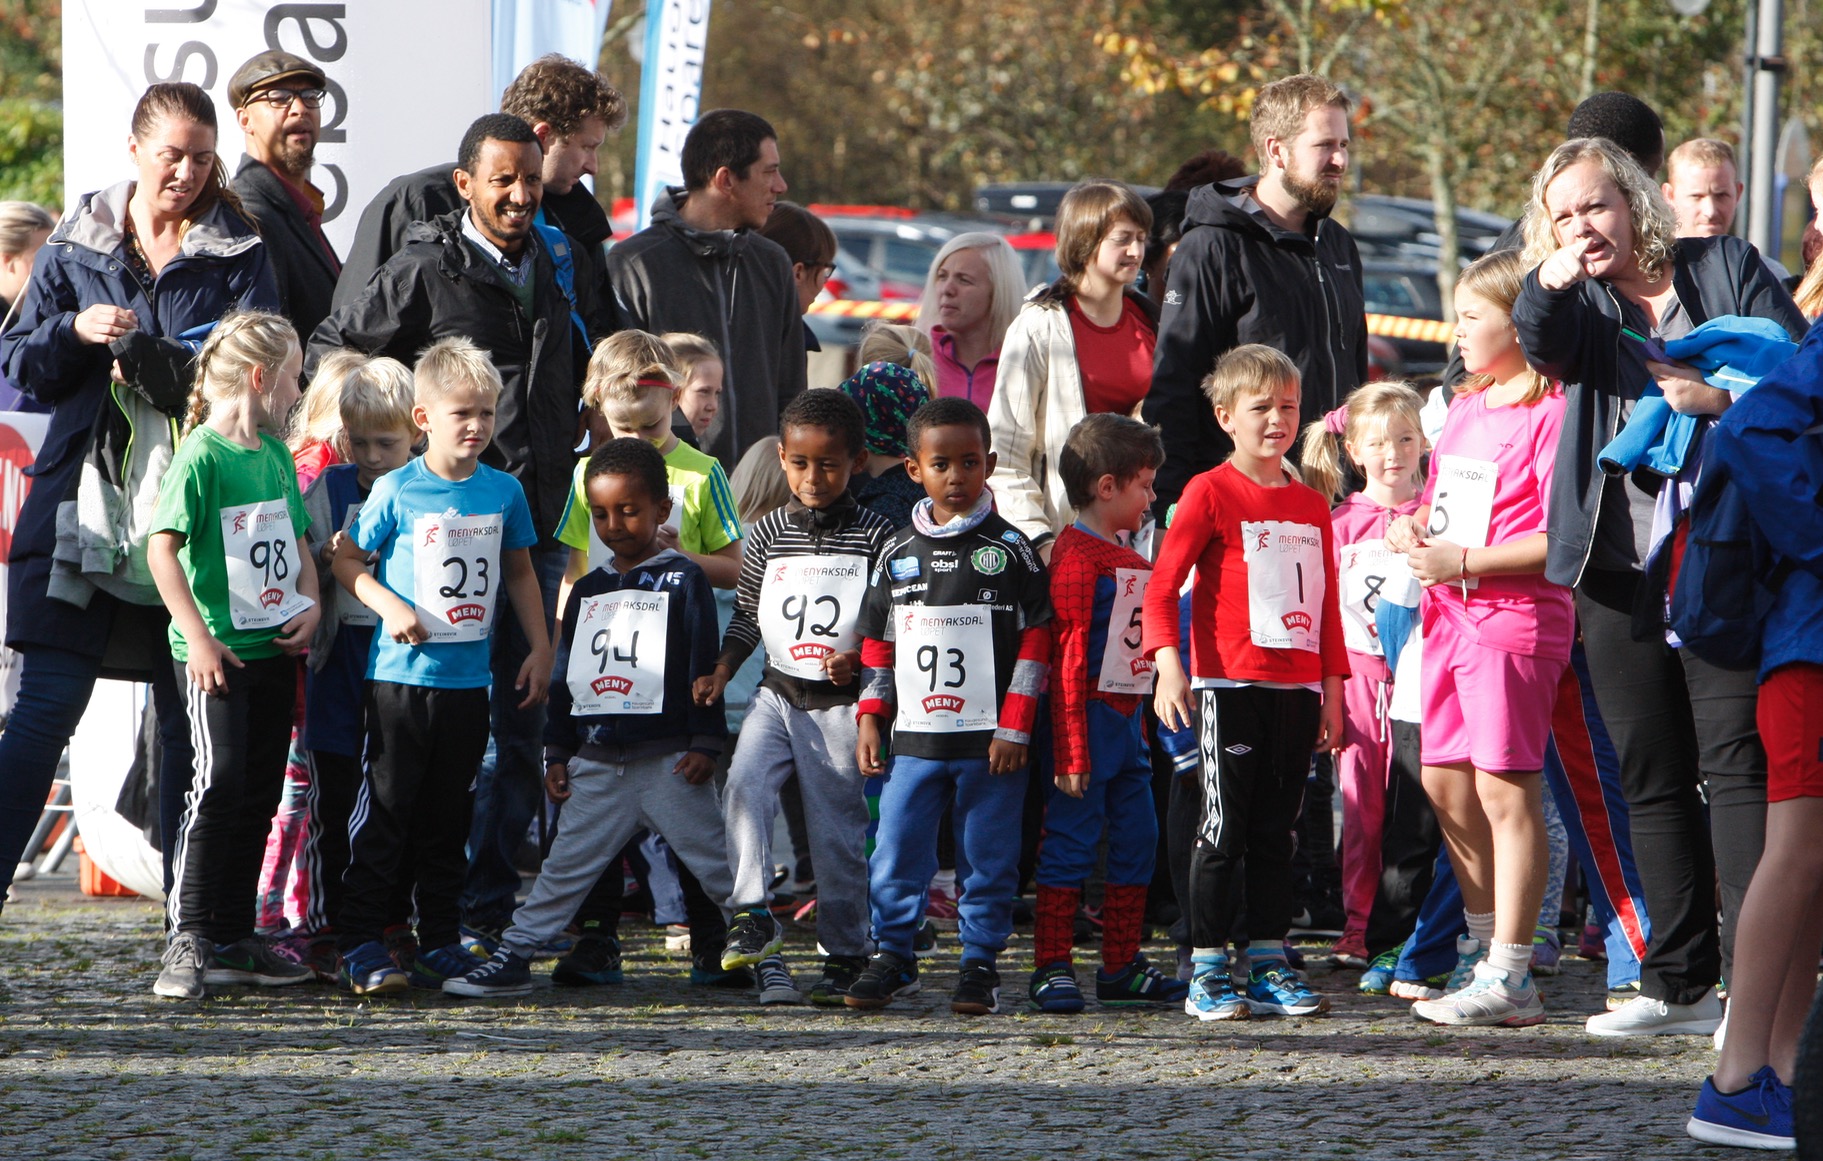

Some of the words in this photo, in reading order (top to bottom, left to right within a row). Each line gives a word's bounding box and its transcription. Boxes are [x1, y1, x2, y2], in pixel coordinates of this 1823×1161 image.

[1429, 492, 1449, 536] 5
[448, 525, 499, 538] MENYAKSDAL
[448, 537, 473, 547] LØPET
[1280, 544, 1301, 553] LØPET
[250, 539, 288, 587] 98
[931, 559, 959, 568] obs!
[439, 556, 489, 598] 23
[1296, 562, 1304, 604] 1
[261, 592, 281, 605] MENY
[1363, 575, 1386, 613] 8
[451, 607, 483, 620] MENY
[1005, 604, 1014, 612] AS
[782, 594, 840, 640] 92
[920, 616, 984, 627] MENYAKSDAL
[1286, 614, 1311, 627] MENY
[1124, 607, 1142, 650] 5
[591, 629, 639, 674] 94
[793, 645, 831, 658] MENY
[917, 645, 966, 692] 93
[596, 680, 629, 692] MENY
[926, 698, 960, 710] MENY
